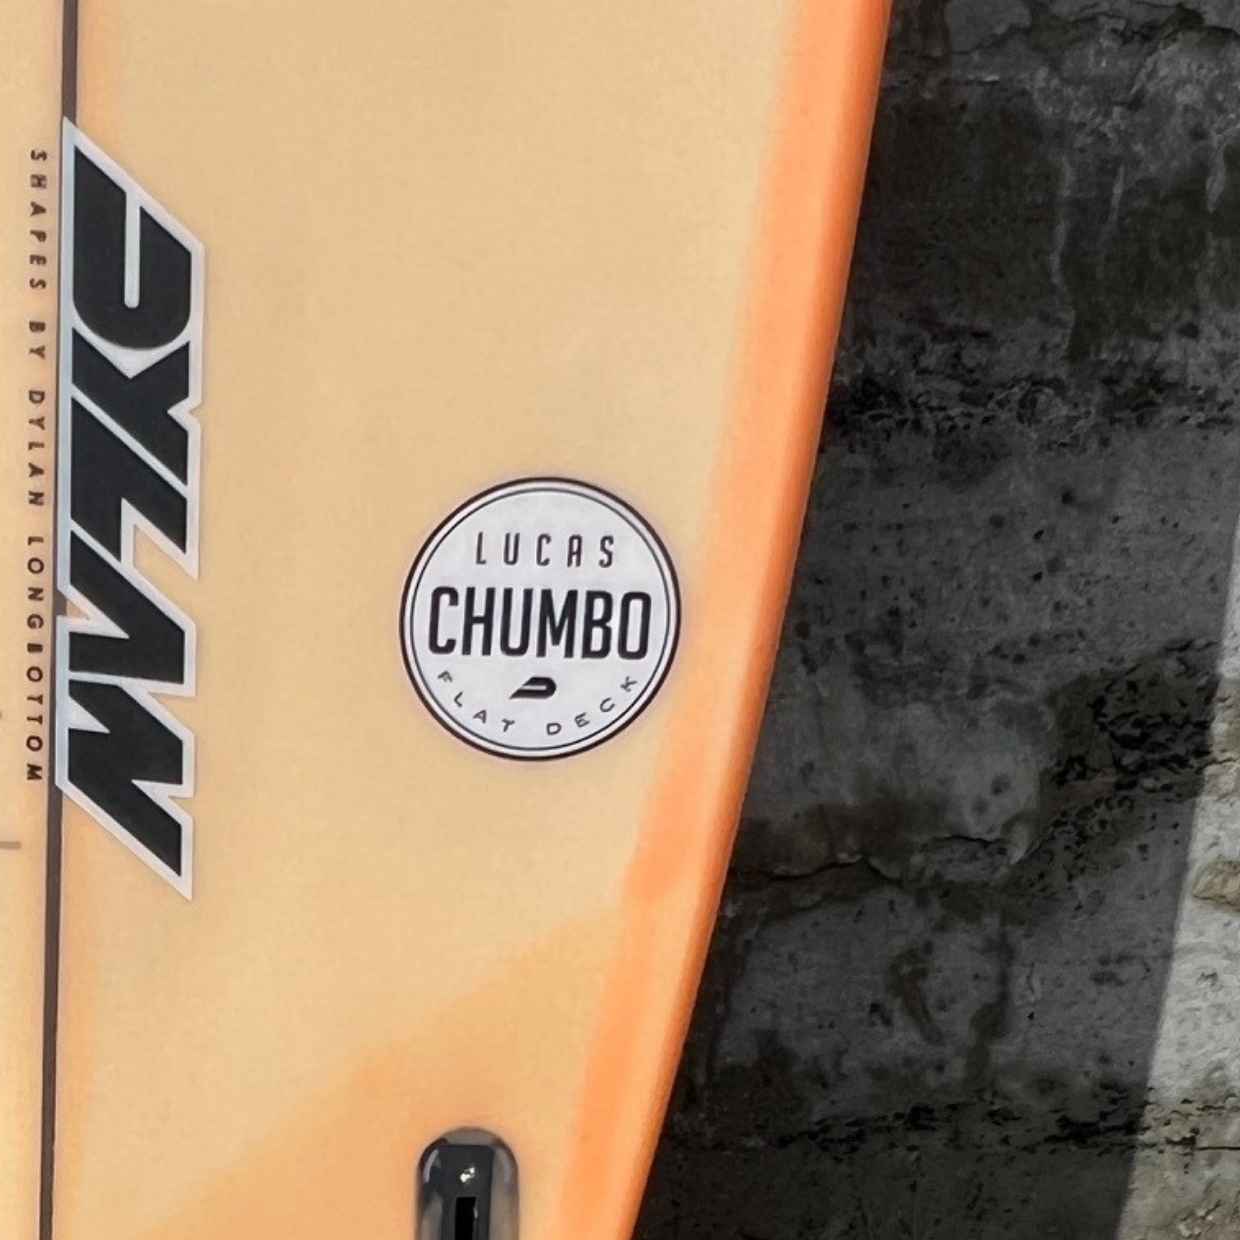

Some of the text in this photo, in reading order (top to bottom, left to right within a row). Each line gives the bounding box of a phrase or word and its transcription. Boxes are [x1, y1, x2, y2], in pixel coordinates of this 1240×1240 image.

[28, 149, 48, 290] SHAPES
[28, 320, 47, 360] BY
[27, 389, 47, 506] DYLAN
[66, 144, 192, 878] DYLAN
[475, 531, 615, 569] LUCAS
[428, 585, 652, 661] CHUMBO
[437, 670, 638, 736] FLAT DECK
